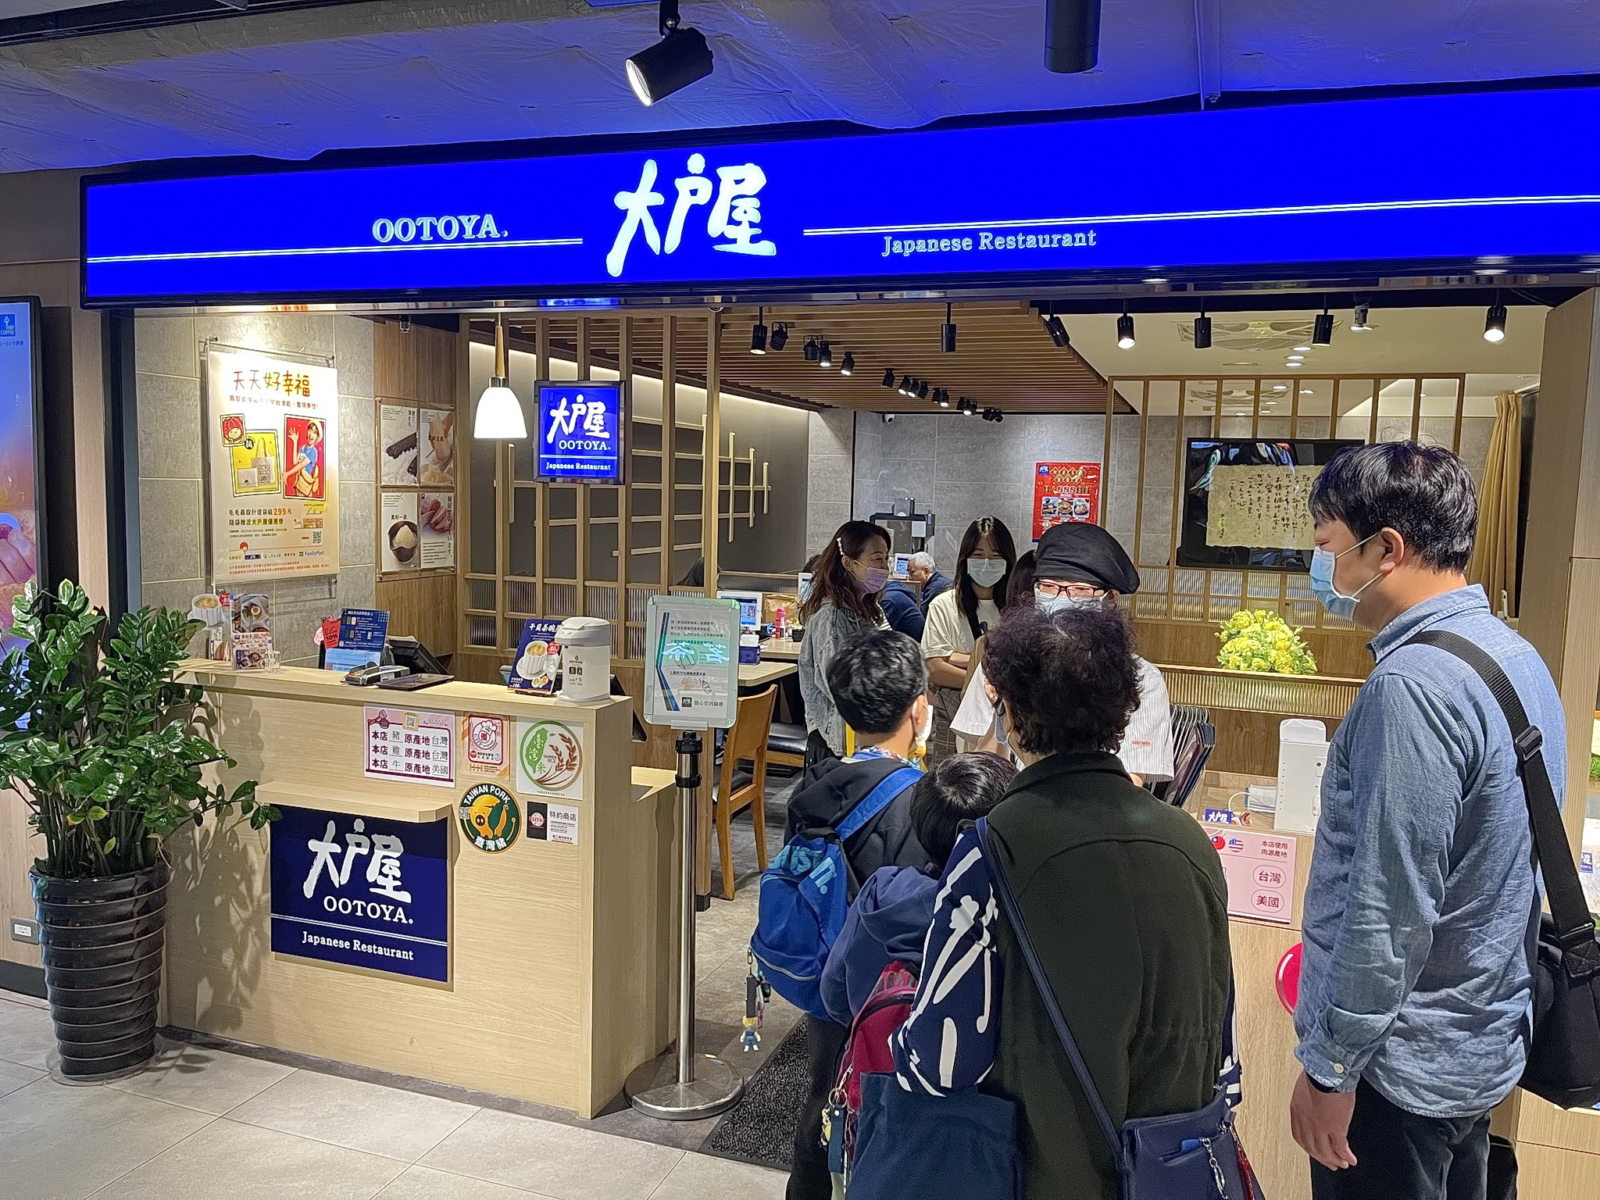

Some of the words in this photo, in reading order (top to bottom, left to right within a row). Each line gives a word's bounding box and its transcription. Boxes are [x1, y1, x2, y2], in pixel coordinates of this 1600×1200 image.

[881, 235, 973, 257] Japanese
[978, 229, 1097, 250] Restaurant
[233, 369, 310, 397] 天天好幸福
[546, 462, 574, 470] Japanese
[372, 730, 388, 741] 本店
[405, 734, 430, 746] 原產地
[432, 736, 448, 746] 台灣
[372, 745, 388, 755] 本店
[405, 748, 430, 760] 原產地
[432, 751, 448, 761] 台灣
[372, 758, 388, 769] 本店
[392, 760, 400, 768] 牛
[405, 763, 430, 775] 原產地
[432, 765, 448, 775] 美國
[463, 785, 488, 805] TAIWAN
[490, 786, 510, 804] PORK
[550, 811, 576, 821] 特約商店
[1262, 840, 1288, 849] 本店使用
[1258, 870, 1281, 884] 台灣
[1257, 895, 1279, 908] 美國
[302, 931, 350, 949] Japanese
[353, 940, 414, 960] Restaurant
